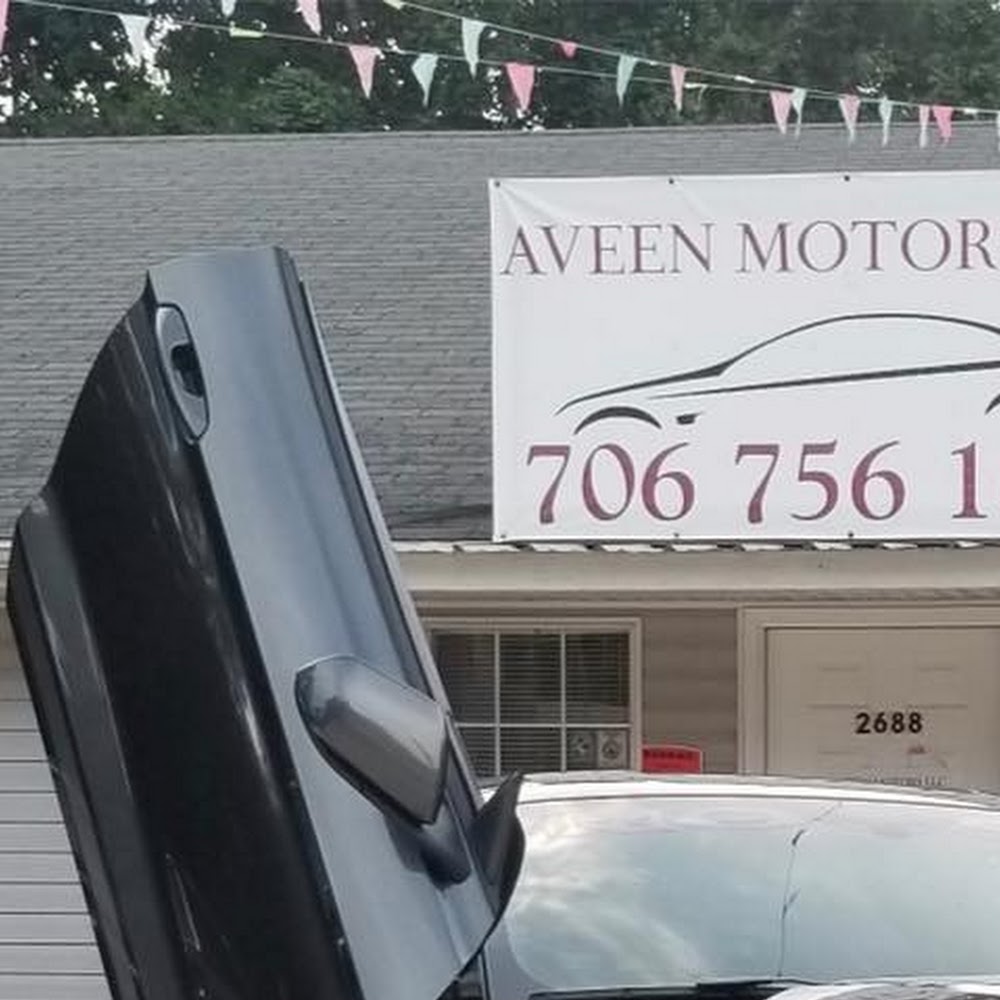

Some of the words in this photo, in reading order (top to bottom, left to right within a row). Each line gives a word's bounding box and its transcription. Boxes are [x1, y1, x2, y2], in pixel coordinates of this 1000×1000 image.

[501, 223, 713, 275] AVEEN
[526, 442, 695, 525] 706
[735, 440, 905, 525] 756
[855, 711, 923, 735] 2688
